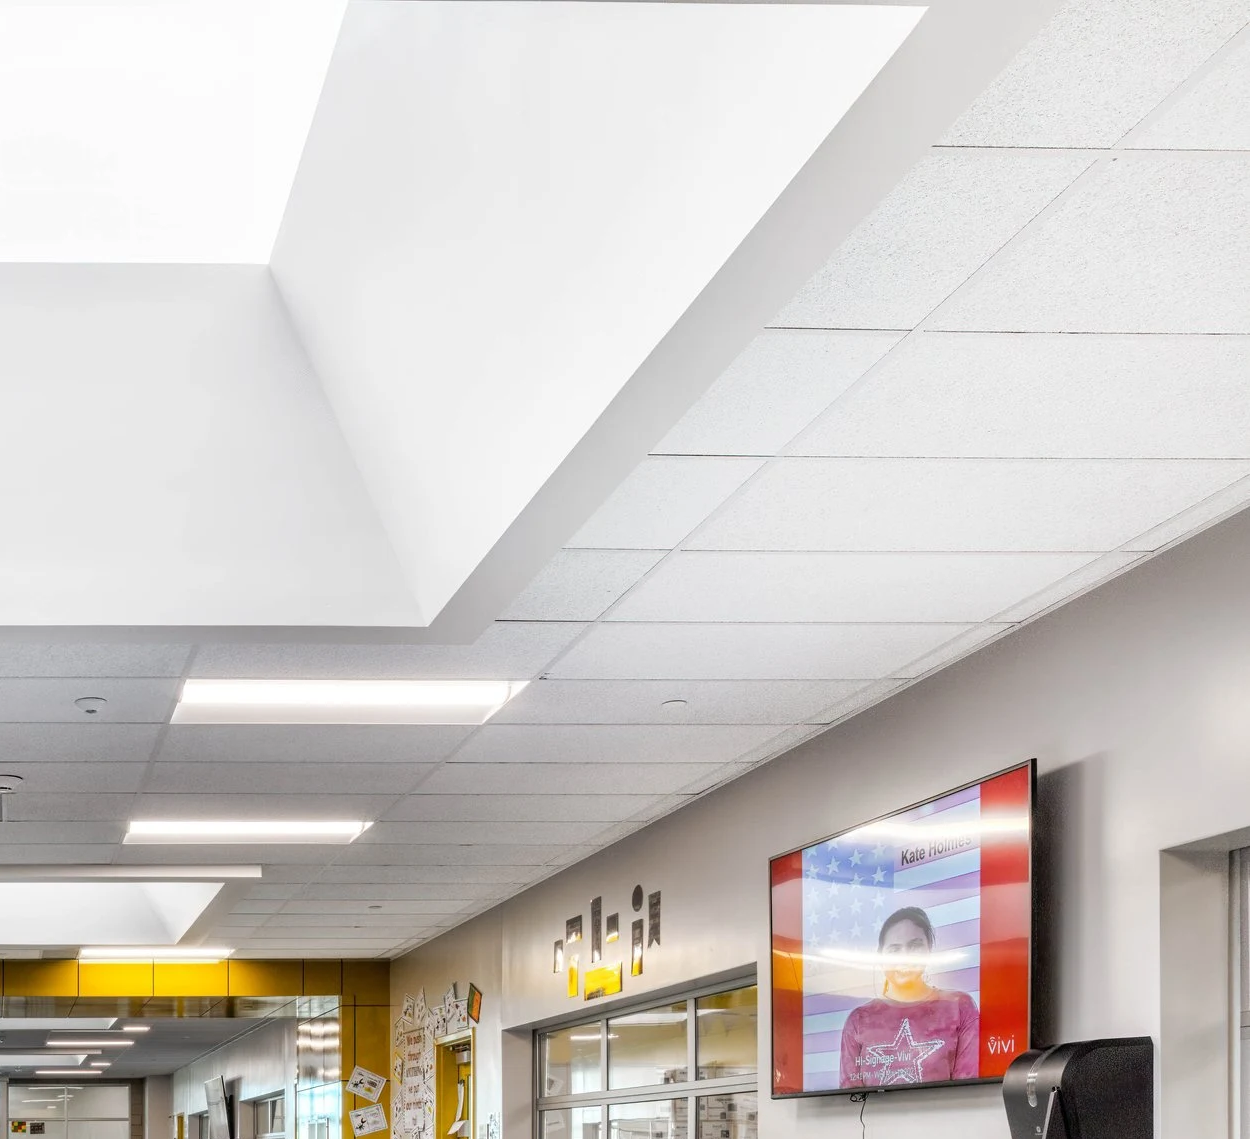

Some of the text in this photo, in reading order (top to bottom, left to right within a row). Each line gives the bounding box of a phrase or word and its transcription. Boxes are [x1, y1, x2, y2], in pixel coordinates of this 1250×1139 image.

[901, 834, 972, 866] Kate Holmes
[855, 1050, 911, 1067] HI-Signage-Vivi
